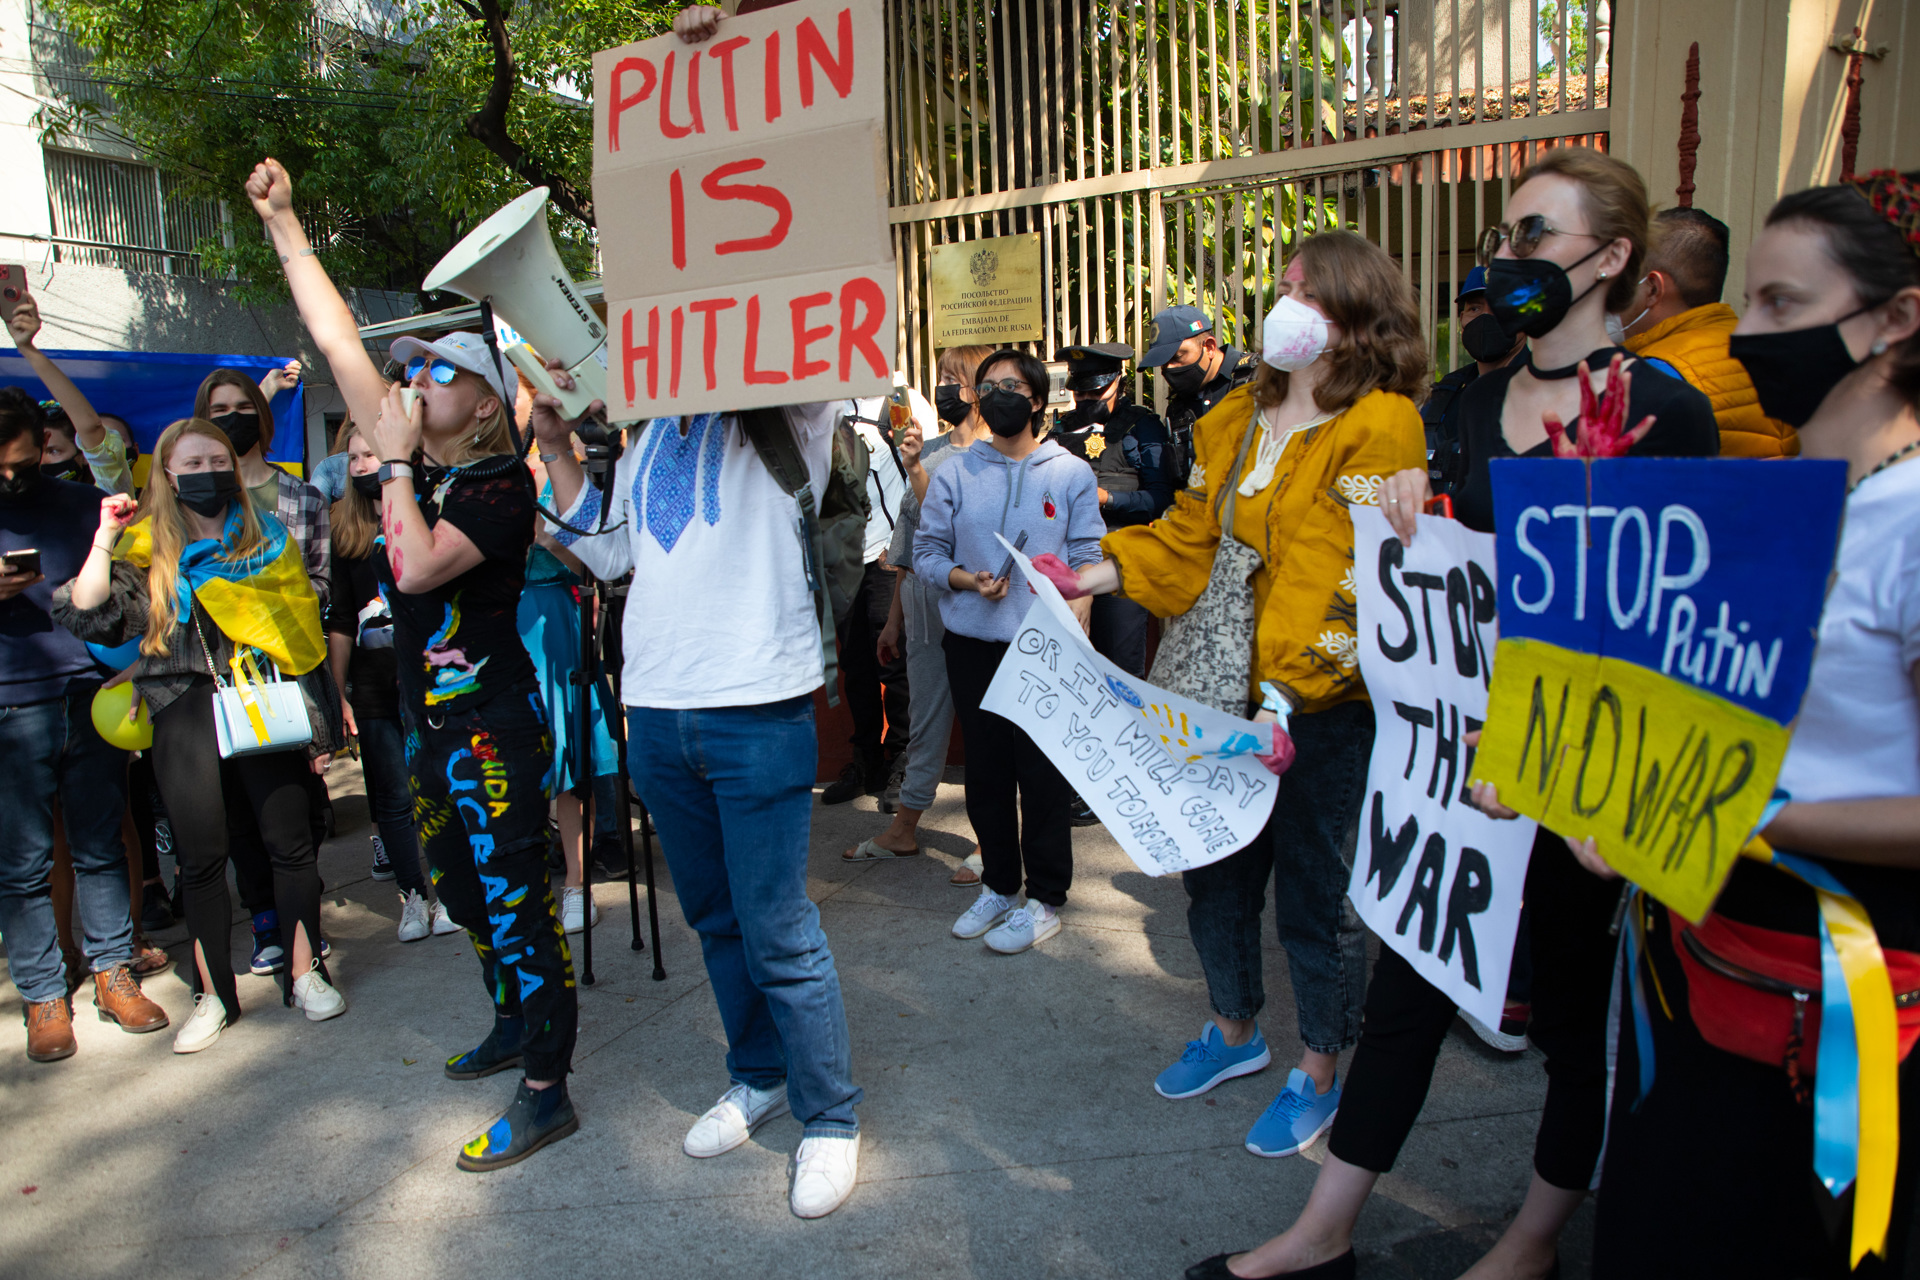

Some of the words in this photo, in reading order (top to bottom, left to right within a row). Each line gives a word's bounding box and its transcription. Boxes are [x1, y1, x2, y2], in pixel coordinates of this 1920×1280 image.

[608, 7, 855, 153] PUTIN
[670, 157, 793, 271] IS
[556, 278, 590, 323] STEREN
[622, 276, 889, 408] HITLER
[940, 298, 988, 311] РОССИЙСКОЙ
[988, 296, 1033, 307] ФЕДЕРАЦИИ
[942, 329, 951, 337] LA
[951, 324, 996, 337] FEDERACIÓN
[998, 325, 1008, 333] DE
[1010, 323, 1033, 332] RUSIA
[961, 288, 1009, 299] ПОСОЛЬСТВО
[961, 315, 998, 326] EMBAJADA
[999, 314, 1010, 322] DE
[1377, 537, 1496, 692] STOP
[1512, 504, 1710, 636] STOP
[1017, 627, 1063, 672] OR
[1059, 662, 1119, 719] IT
[1017, 669, 1061, 719] TO
[1062, 712, 1116, 782] YOU
[1517, 674, 1622, 819] NO
[1623, 706, 1756, 888] WAR
[1366, 790, 1494, 993] WAR
